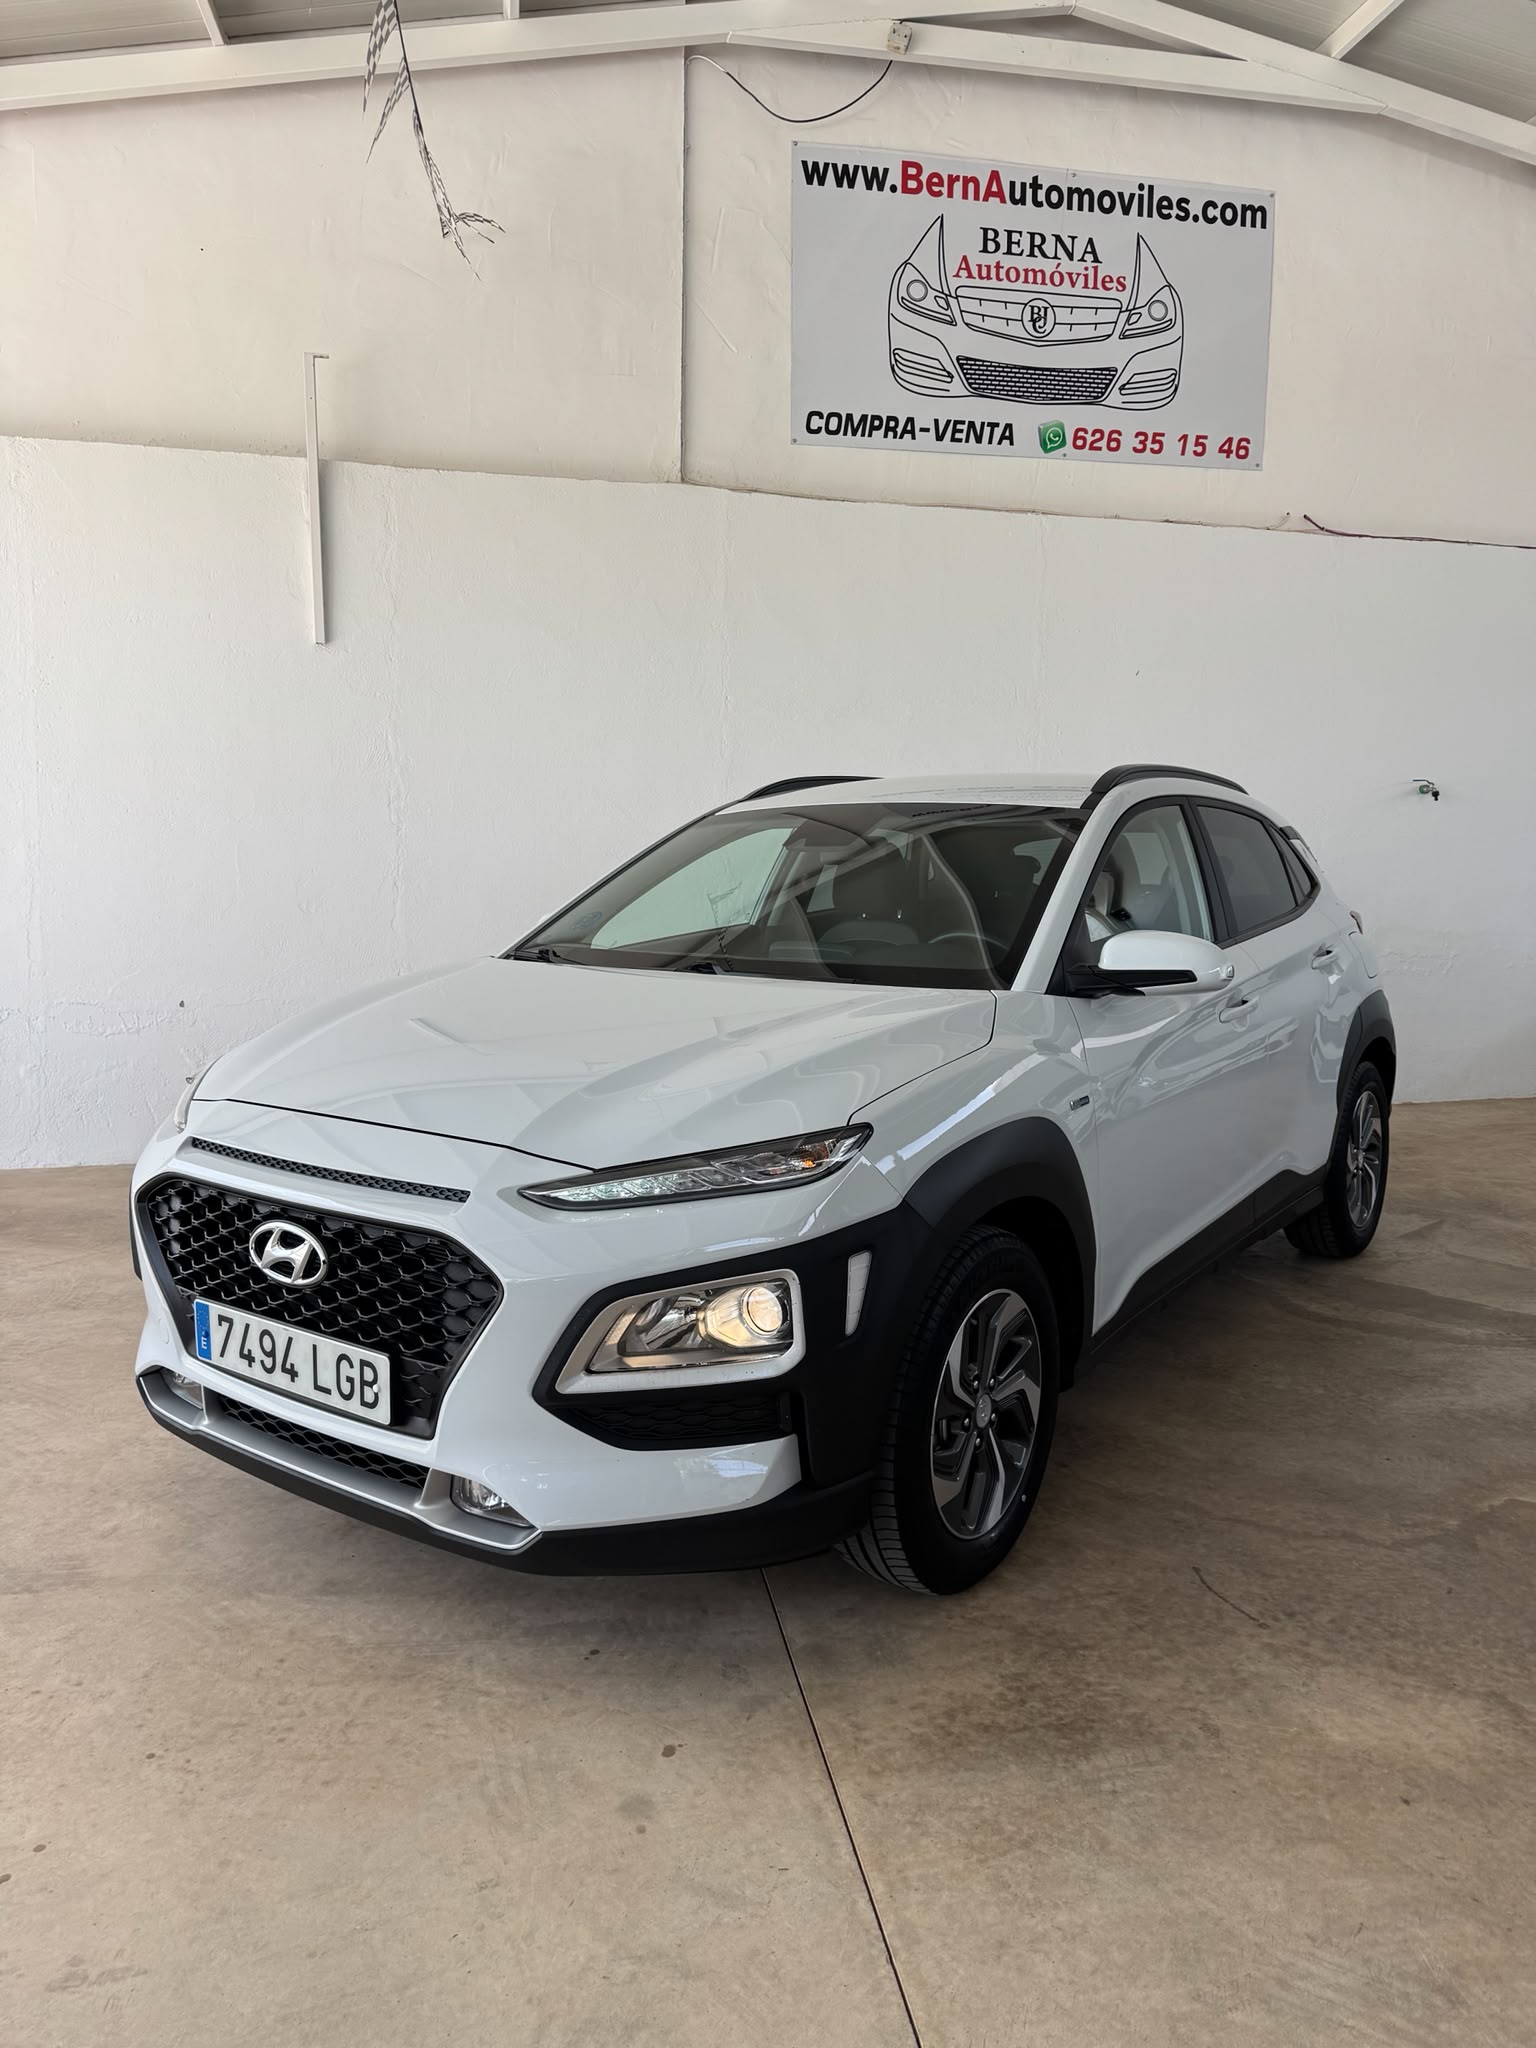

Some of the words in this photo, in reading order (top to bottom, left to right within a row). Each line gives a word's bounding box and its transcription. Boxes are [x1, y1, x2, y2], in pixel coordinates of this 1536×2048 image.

[801, 160, 1268, 229] www.BernAutomoviles.com
[978, 227, 1102, 264] BERNA
[952, 255, 1128, 292] Automóviles
[805, 410, 1015, 446] COMPRA-VENTA
[1071, 426, 1123, 453] 626
[1131, 431, 1166, 455] 35
[1177, 433, 1208, 458] 15
[1217, 436, 1252, 460] 46
[217, 1313, 299, 1383] 7494
[312, 1343, 379, 1411] LGB
